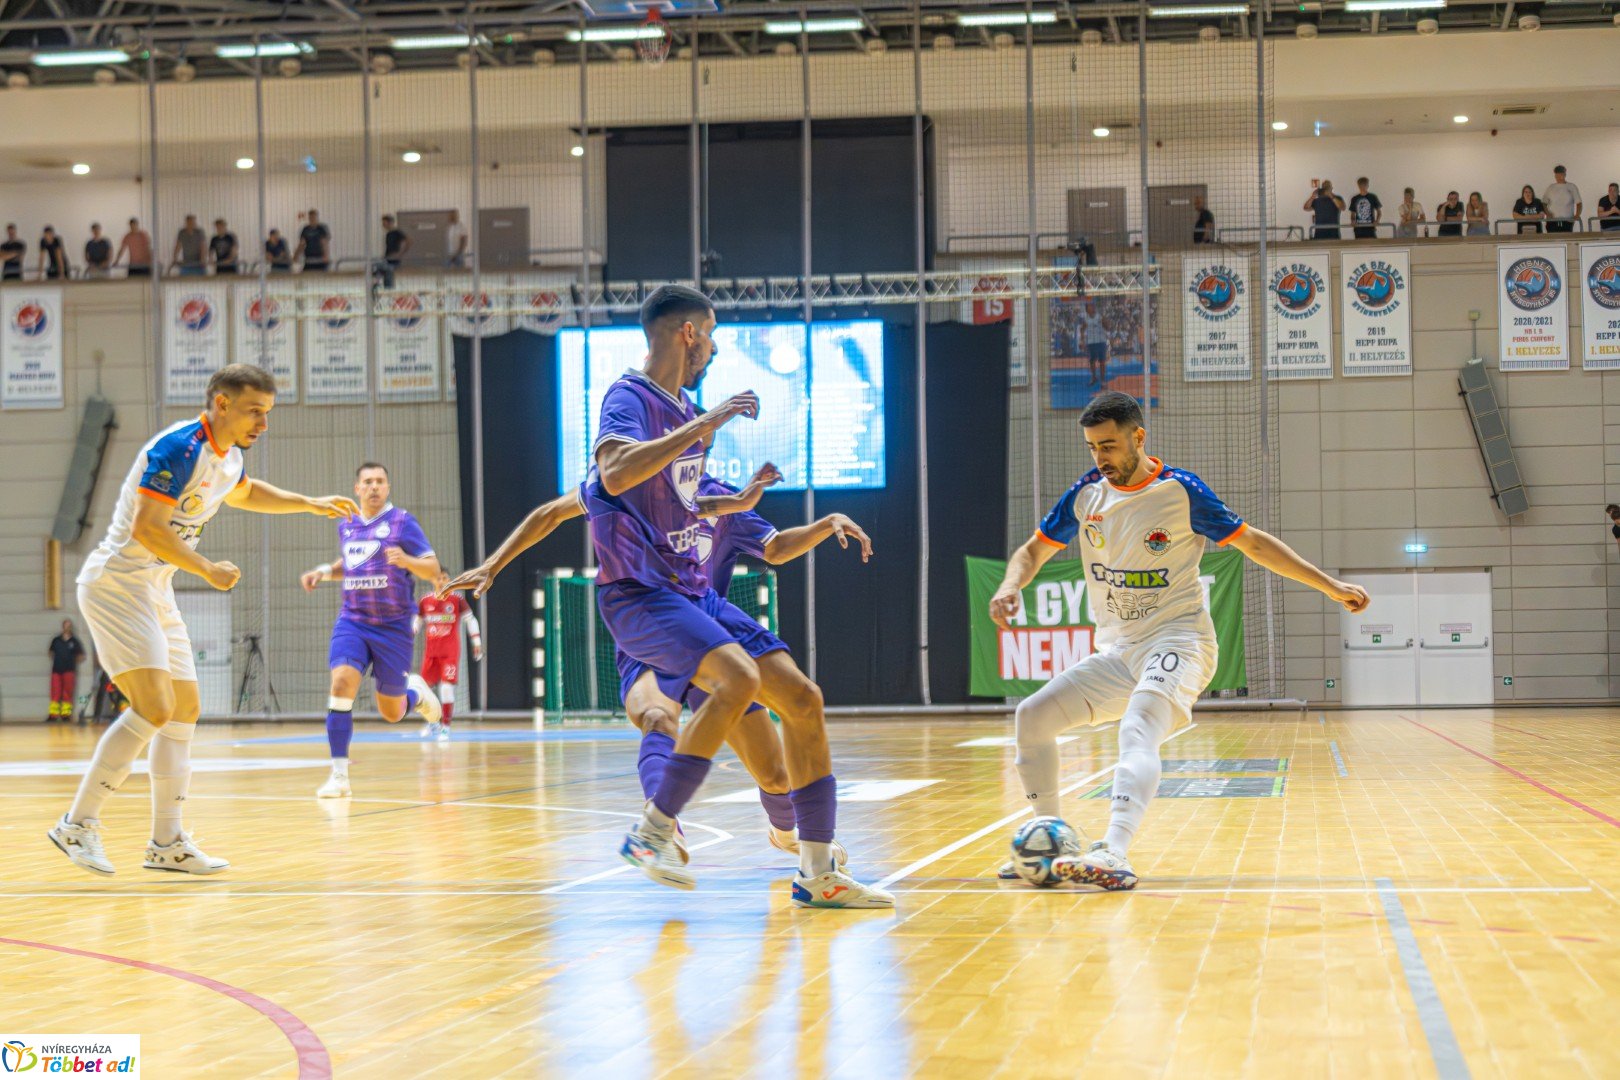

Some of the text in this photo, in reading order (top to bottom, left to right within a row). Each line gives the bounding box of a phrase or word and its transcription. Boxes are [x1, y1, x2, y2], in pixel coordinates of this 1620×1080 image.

[1347, 263, 1369, 289] BLUE
[1513, 317, 1553, 326] 2020/2021
[1378, 338, 1398, 346] KUPA
[1001, 630, 1091, 680] NEM
[1145, 652, 1179, 672] 20
